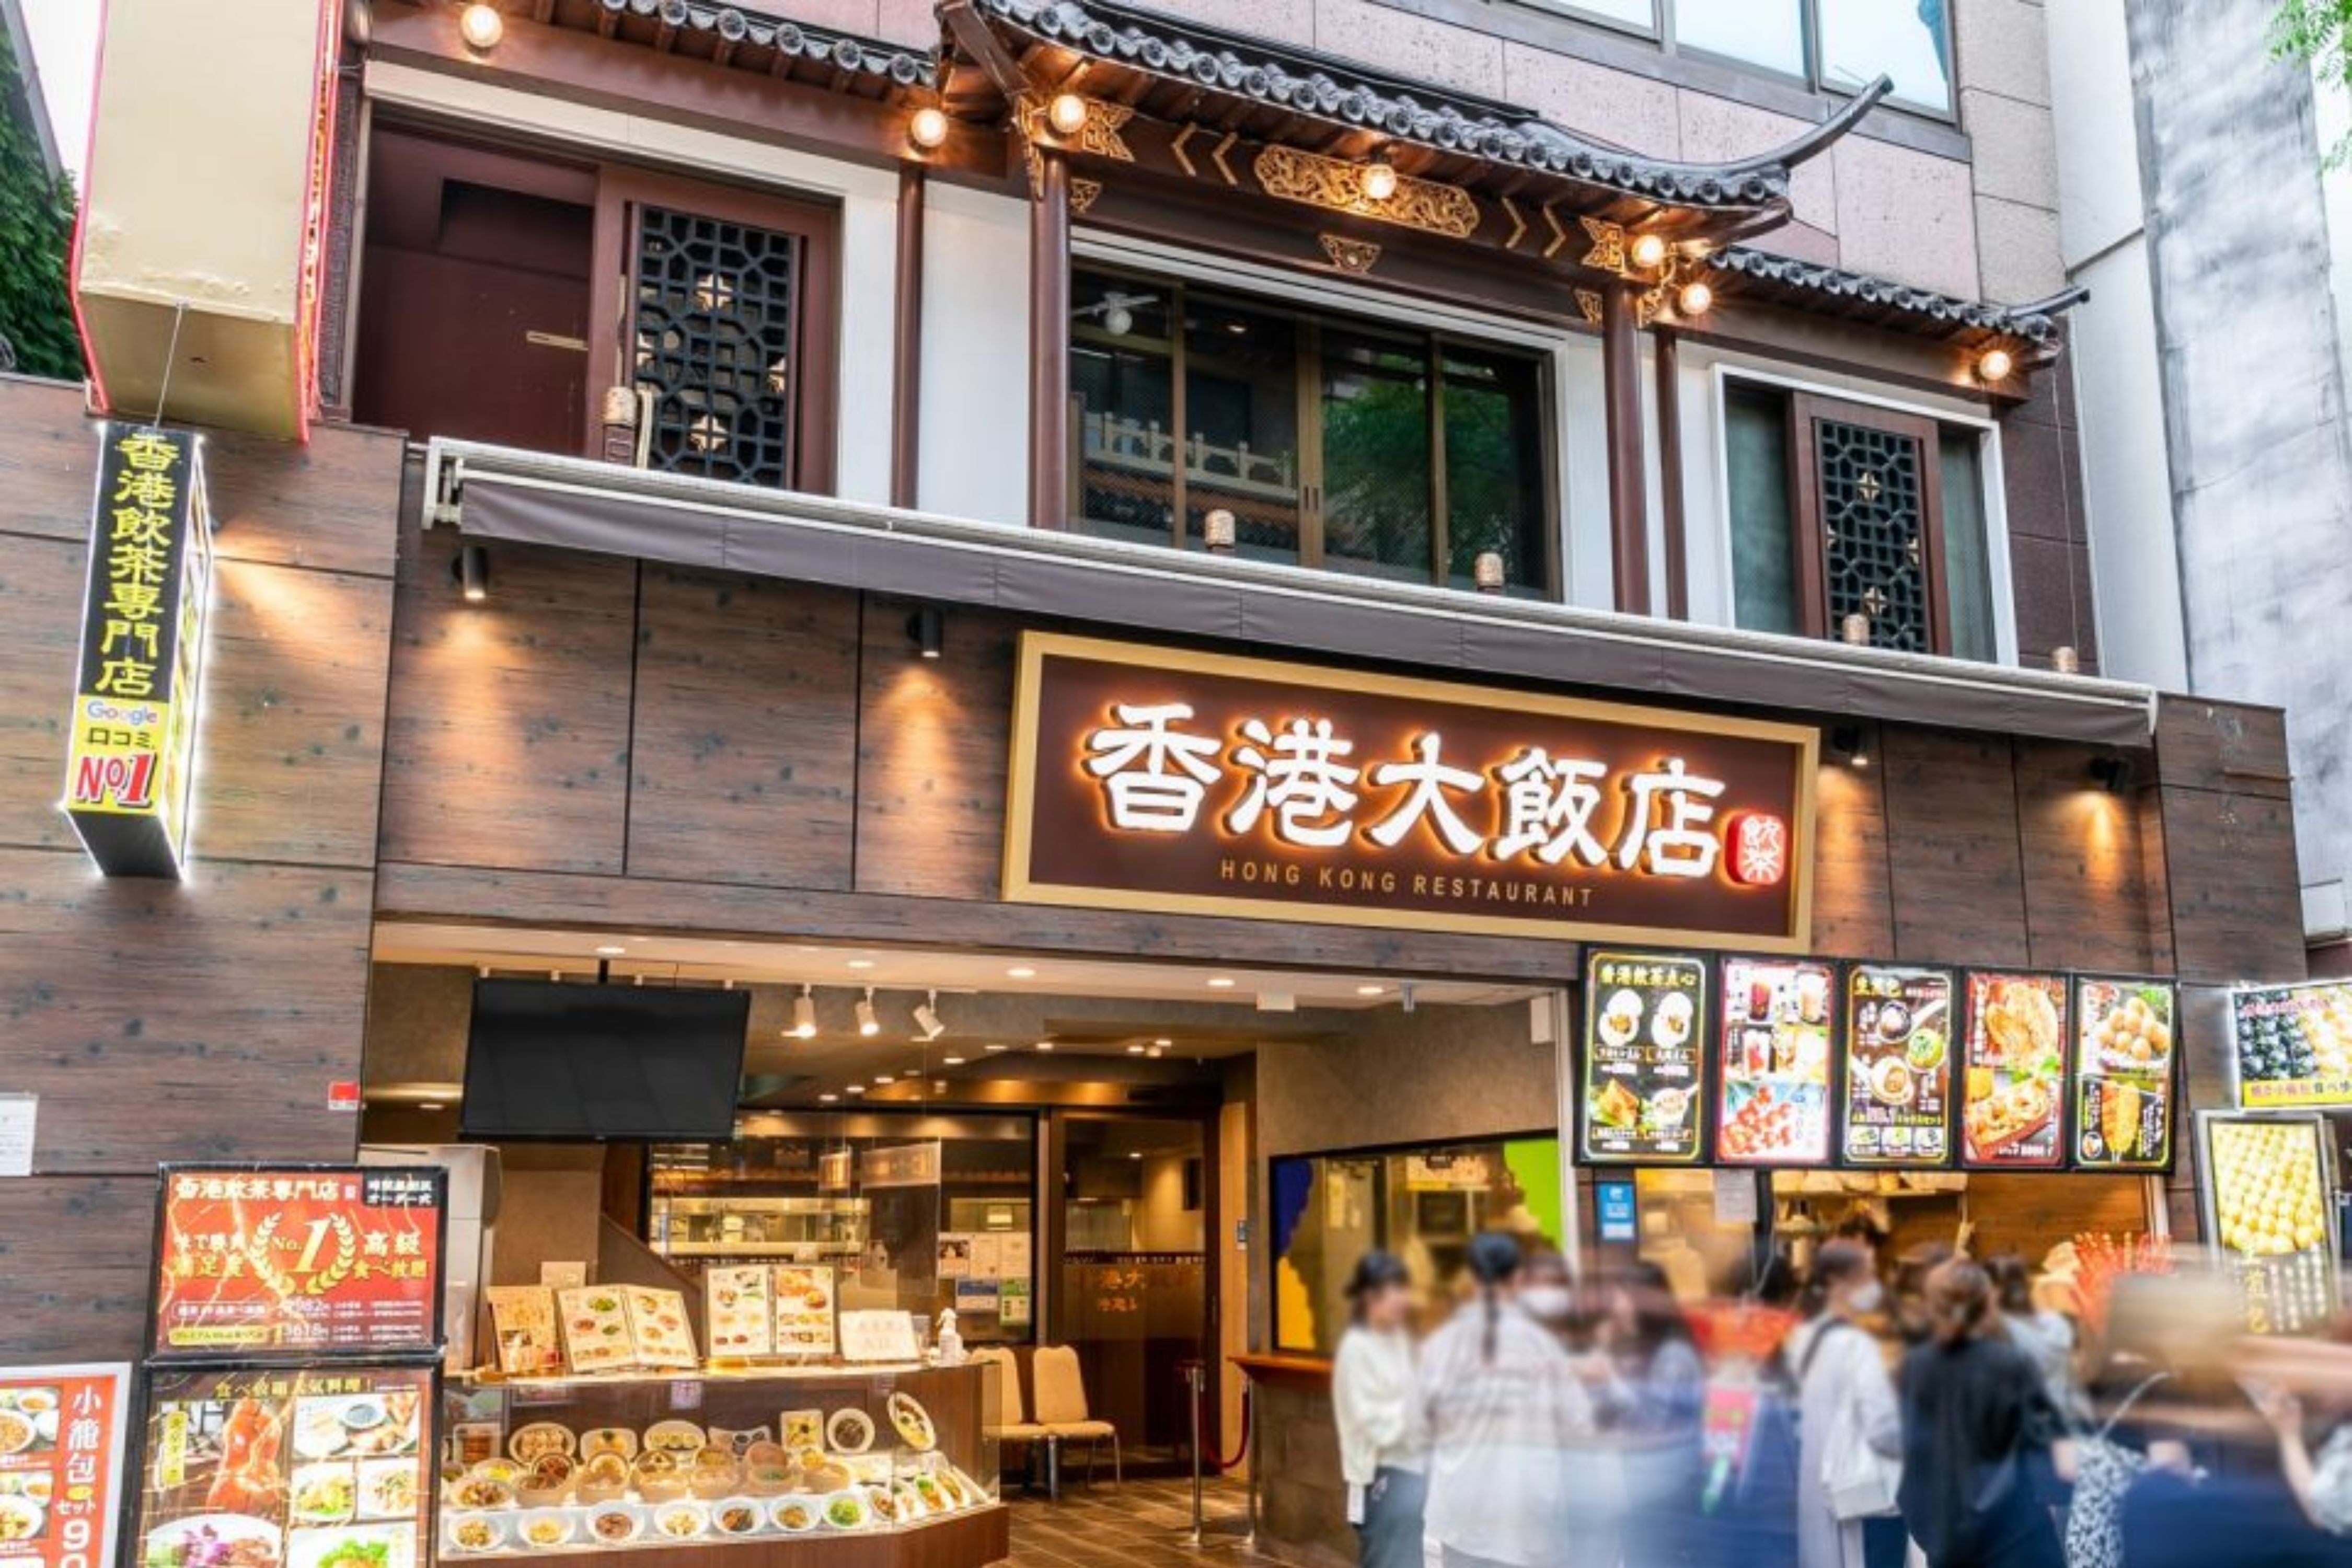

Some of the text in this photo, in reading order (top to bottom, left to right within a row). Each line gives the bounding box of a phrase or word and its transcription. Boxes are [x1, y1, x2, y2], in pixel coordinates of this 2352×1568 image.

[95, 432, 179, 697] 香港飲茶専門店
[88, 700, 157, 725] Google
[88, 727, 152, 748] 口コミ
[1089, 703, 1726, 875] 香港大飯店
[1221, 858, 1594, 907] HONG KONG RESTAURANT
[56, 1497, 97, 1515] セット
